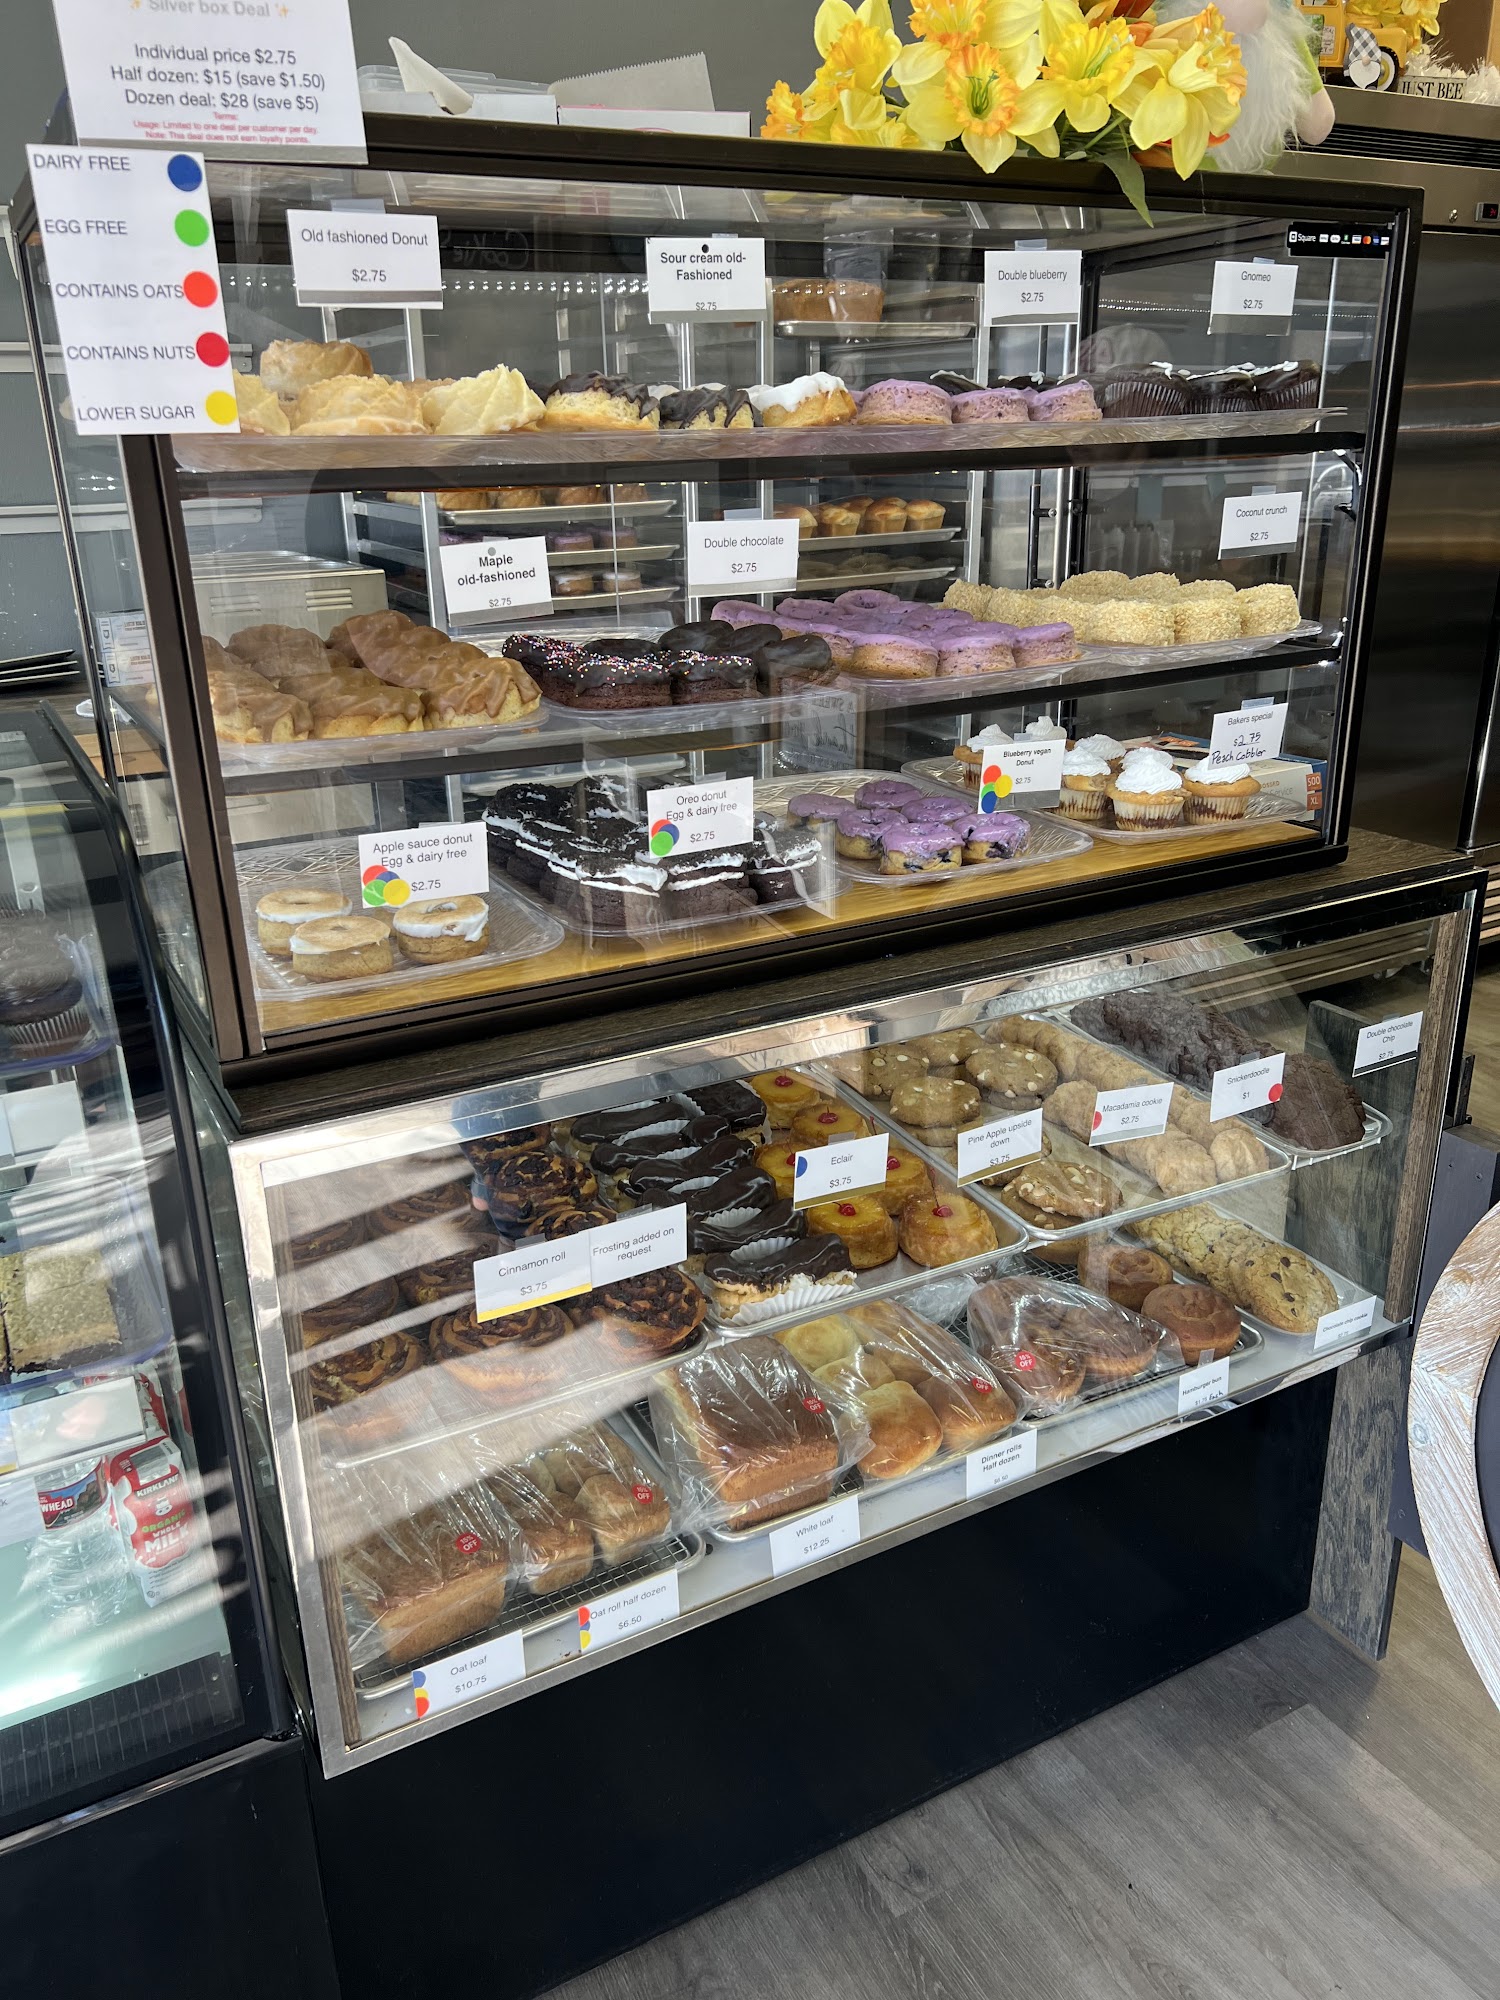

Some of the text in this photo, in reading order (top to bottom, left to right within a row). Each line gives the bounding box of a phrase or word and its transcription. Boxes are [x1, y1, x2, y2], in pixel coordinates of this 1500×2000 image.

[200, 0, 230, 15] box
[233, 1, 271, 16] Deal
[135, 44, 296, 65] Individual price $2.75
[111, 65, 325, 91] Half dozen: $15 (save $1.50)
[1438, 83, 1463, 99] BEE
[125, 88, 319, 113] Dozen deal: $28 (save $5)
[163, 121, 191, 130] Limited
[194, 122, 201, 130] to
[203, 123, 217, 131] one
[220, 122, 236, 131] deal
[238, 124, 251, 133] per
[252, 124, 287, 133] customer
[289, 125, 302, 134] per
[169, 131, 185, 140] This
[187, 132, 203, 141] deal
[206, 132, 224, 142] does
[226, 133, 239, 142] not
[259, 134, 283, 145] loyalty
[33, 154, 131, 171] DAIRY FREE
[44, 219, 128, 236] EGG FREE
[301, 229, 323, 243] Old
[327, 230, 388, 245] fashioned
[392, 232, 428, 246] Donut
[1298, 233, 1316, 243] Square
[660, 252, 746, 264] Sour cream old-
[352, 269, 387, 283] $2.75
[676, 269, 732, 281] Fashioned
[998, 270, 1067, 282] Double blueberry
[1241, 270, 1271, 282] Gnomeo
[55, 283, 184, 298] CONTAINS OATS
[1021, 292, 1044, 303] $2.75
[695, 302, 717, 311] $2.75
[1243, 299, 1263, 310] $2.75
[67, 345, 196, 360] CONTAINS NUTS
[78, 405, 195, 421] LOWER SUGAR
[1236, 505, 1288, 518] Coconut crunch
[704, 536, 784, 549] Double chocolate
[1250, 532, 1269, 542] $2.75
[479, 554, 513, 568] Maple
[731, 563, 757, 574] $2.75
[457, 567, 536, 586] old-fashioned
[489, 597, 512, 608] $2.75
[1228, 711, 1274, 726] Bakers special
[1003, 748, 1052, 758] Blueberry vegan
[1211, 750, 1234, 765] Peach
[1015, 777, 1031, 785] $2.75
[1307, 775, 1320, 787] 500
[676, 790, 727, 806] Oreo donut
[1310, 797, 1319, 805] XL
[666, 802, 737, 822] Egg & dairy free
[373, 833, 473, 855] Apple sauce donut
[690, 831, 715, 843] $2.75
[381, 849, 467, 869] Egg & dairy free
[411, 879, 441, 892] $2.75
[1366, 1020, 1413, 1039] Double chocolate
[1382, 1035, 1395, 1044] Chip
[1227, 1066, 1270, 1086] Snickerdoodle
[1242, 1091, 1250, 1100] $1
[1102, 1097, 1163, 1113] Macadamia cookie
[1120, 1115, 1140, 1126] $2.75
[967, 1119, 1033, 1146] Pine Apple upside
[990, 1137, 1010, 1149] down
[831, 1154, 853, 1166] Eclair
[829, 1177, 852, 1188] $3.75
[592, 1227, 675, 1257] Frosting added on
[617, 1245, 652, 1262] request
[498, 1252, 567, 1278] Cinnamon roll
[520, 1281, 548, 1297] $3.75
[976, 1382, 989, 1390] OFF
[1182, 1376, 1222, 1396] Hamburger bun
[981, 1443, 1022, 1464] Dinner rolls
[982, 1453, 1020, 1472] Half dozen
[40, 1498, 73, 1512] WHEAD
[152, 1521, 181, 1538] WHOLE
[796, 1515, 834, 1538] White loaf
[144, 1522, 189, 1553] MILK
[460, 1535, 473, 1544] 15%
[463, 1539, 477, 1551] OFF
[804, 1537, 830, 1554] $12.25
[590, 1584, 667, 1620] Oat roll half dozen
[618, 1615, 642, 1630] $6.50
[450, 1655, 488, 1676] Oat loaf
[455, 1675, 487, 1693] $10.75
